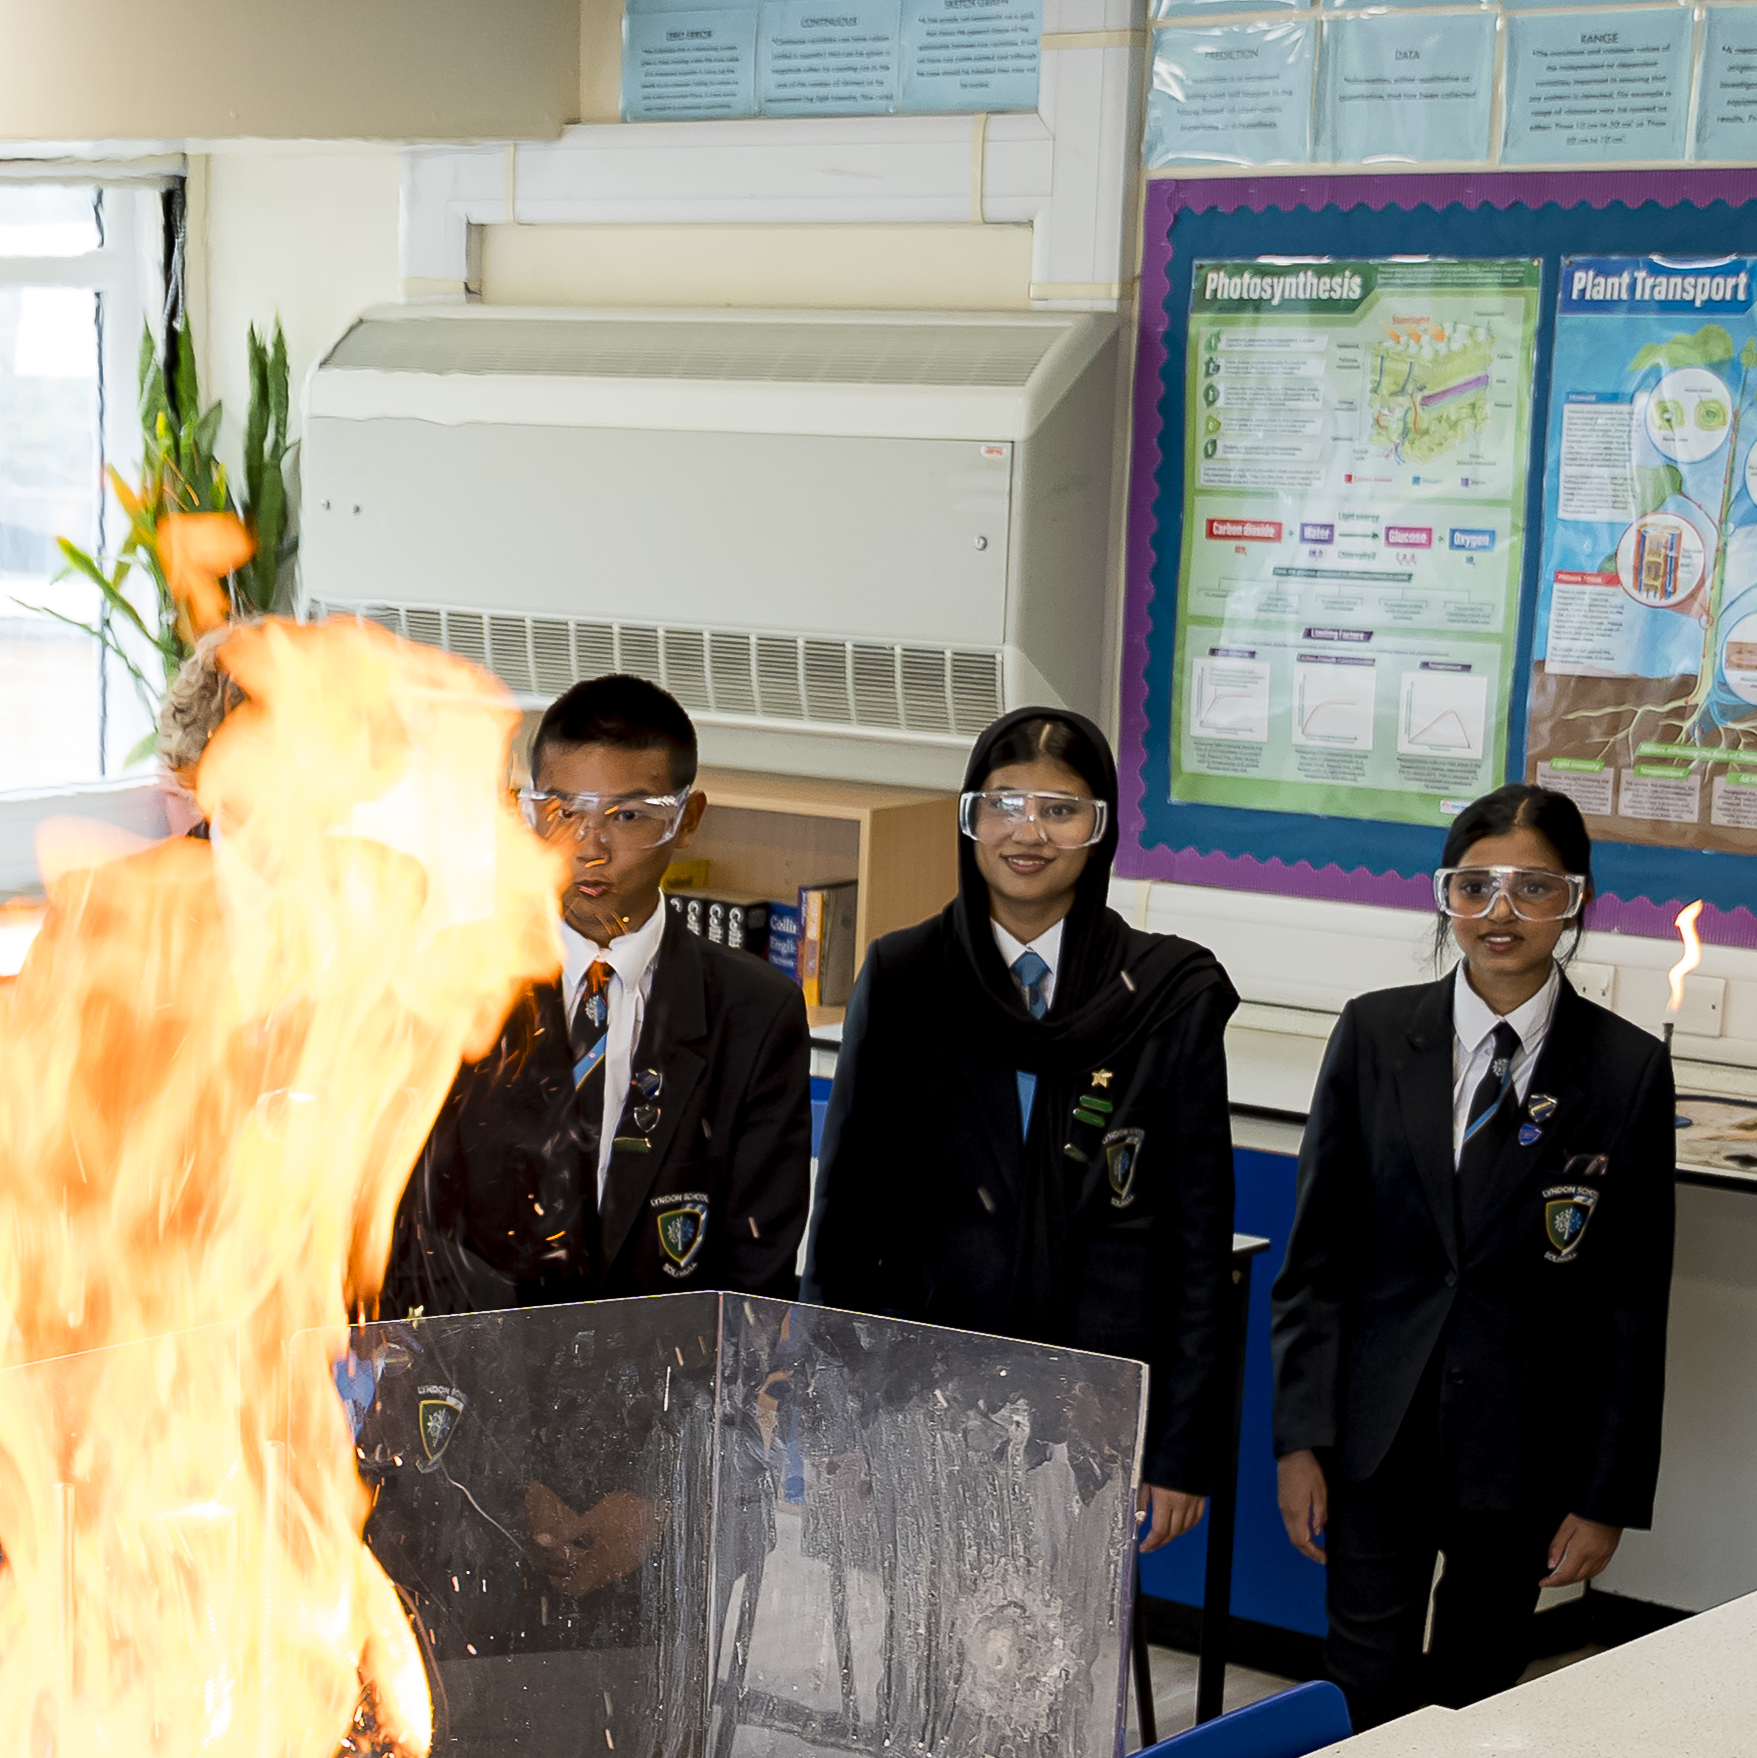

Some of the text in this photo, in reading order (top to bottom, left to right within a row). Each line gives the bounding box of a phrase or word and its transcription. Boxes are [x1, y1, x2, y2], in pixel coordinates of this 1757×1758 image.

[1580, 33, 1619, 44] RANGE
[1395, 50, 1421, 60] DATA
[1205, 267, 1362, 305] Photosynthesis
[1571, 269, 1748, 308] Plant Transport
[1213, 521, 1243, 536] Carbon
[1303, 525, 1331, 540] Water
[1388, 529, 1427, 544] Glucose
[1454, 531, 1490, 548] Oxygen
[1542, 1186, 1575, 1199] LYNDON
[650, 1194, 682, 1207] LYNDON
